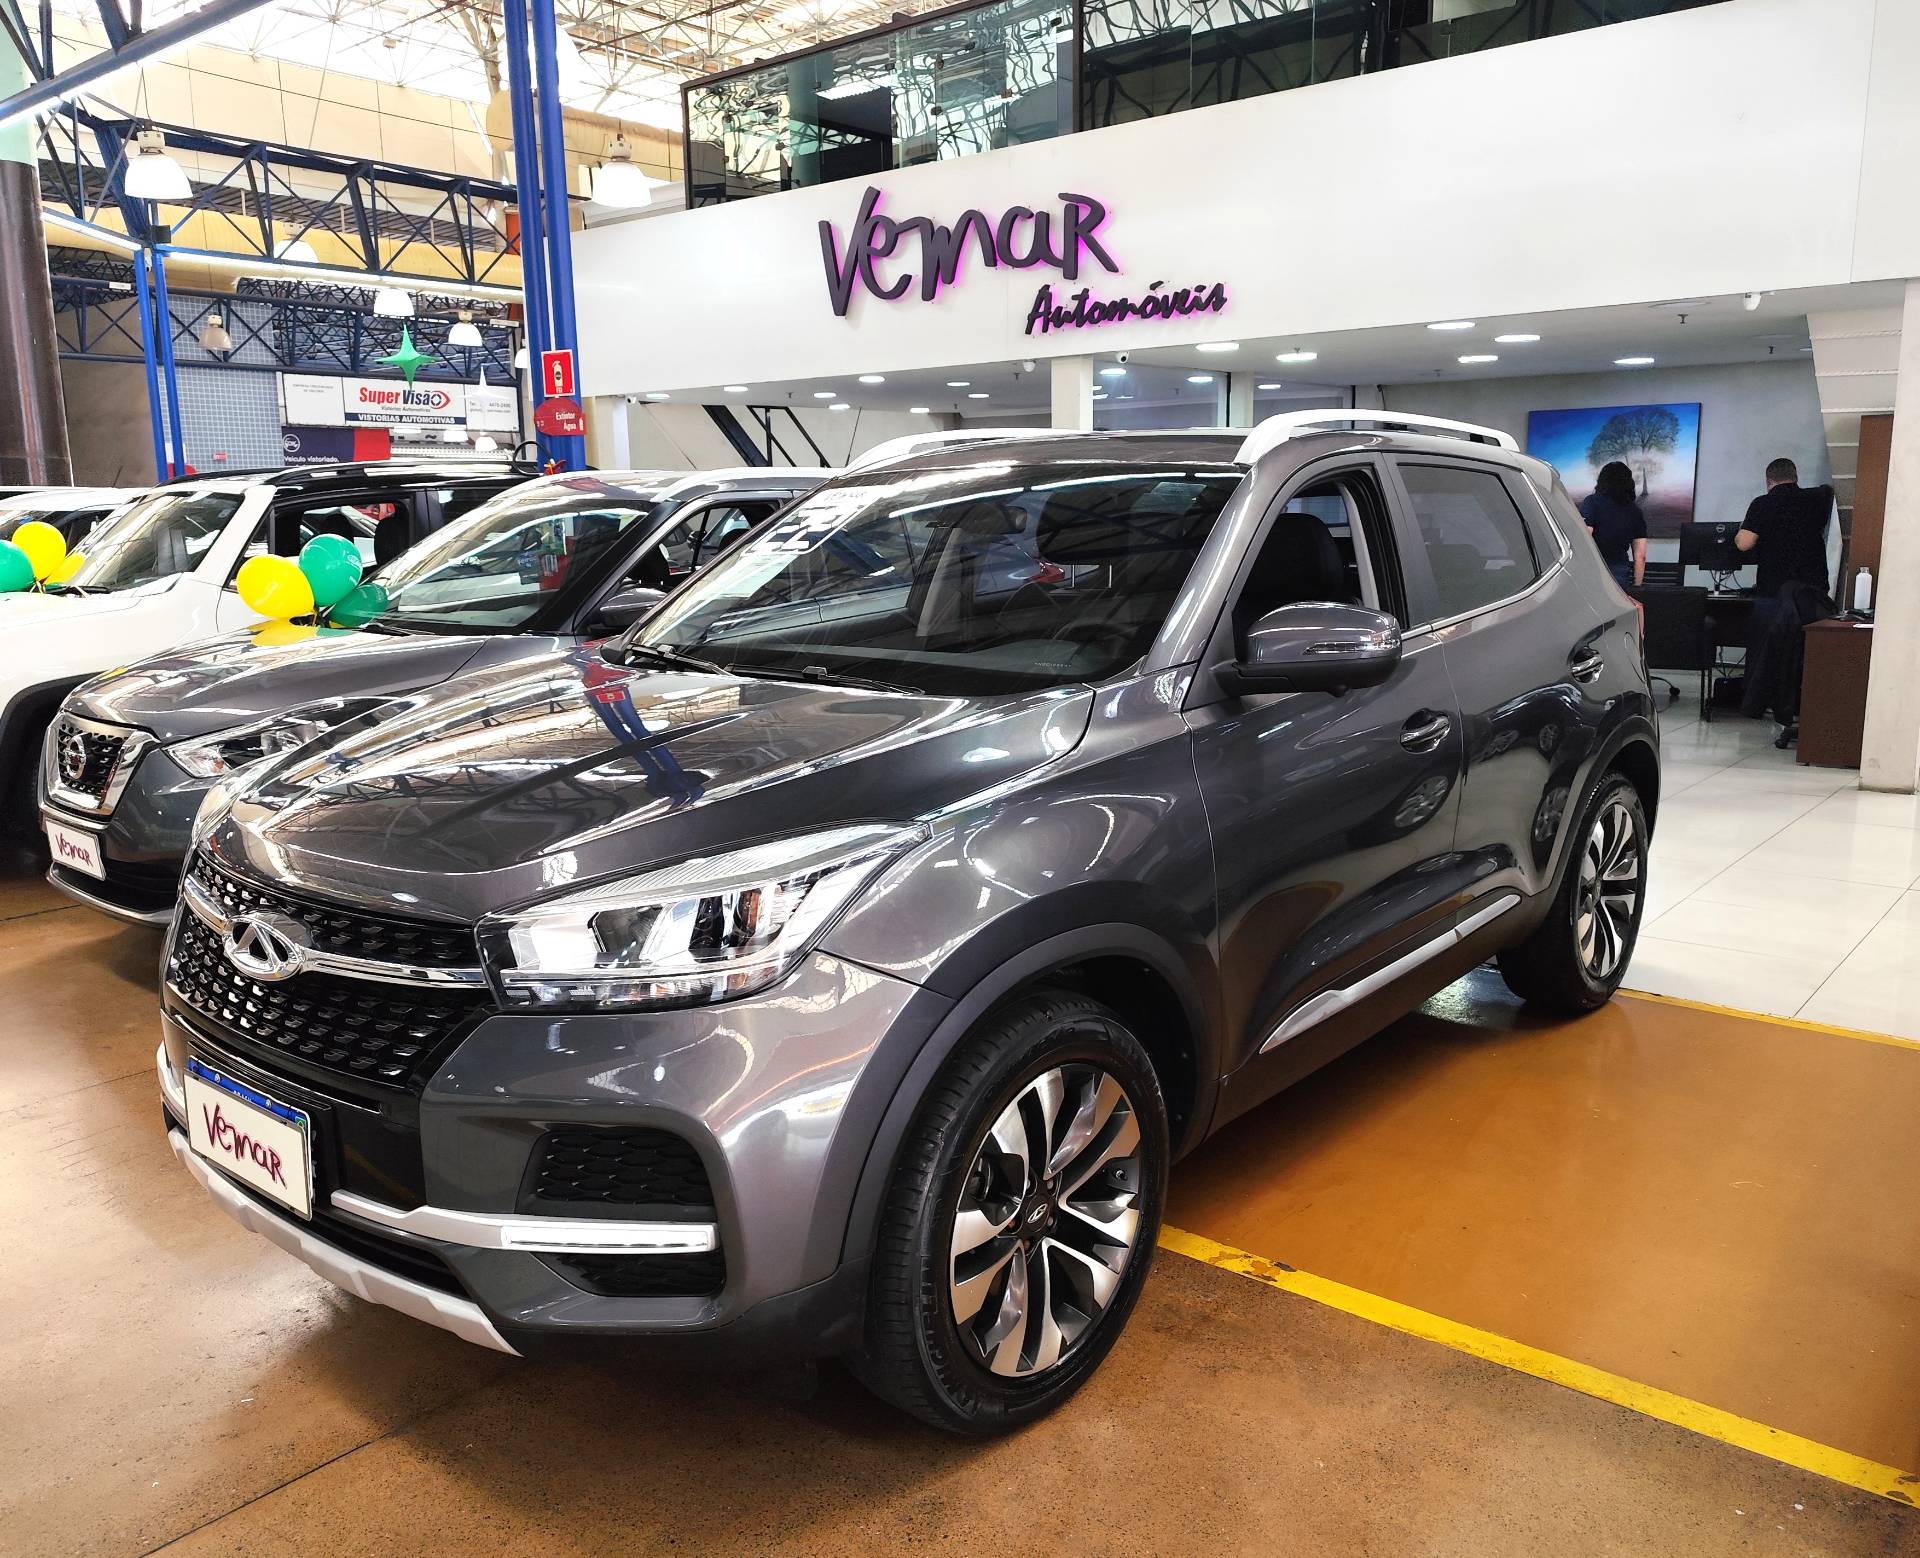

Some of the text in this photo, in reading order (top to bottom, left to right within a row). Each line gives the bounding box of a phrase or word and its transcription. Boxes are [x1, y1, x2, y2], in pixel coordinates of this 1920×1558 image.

[1025, 281, 1227, 335] Automóveis
[358, 414, 455, 424] VISTORIAS AUTOMOTIVAS
